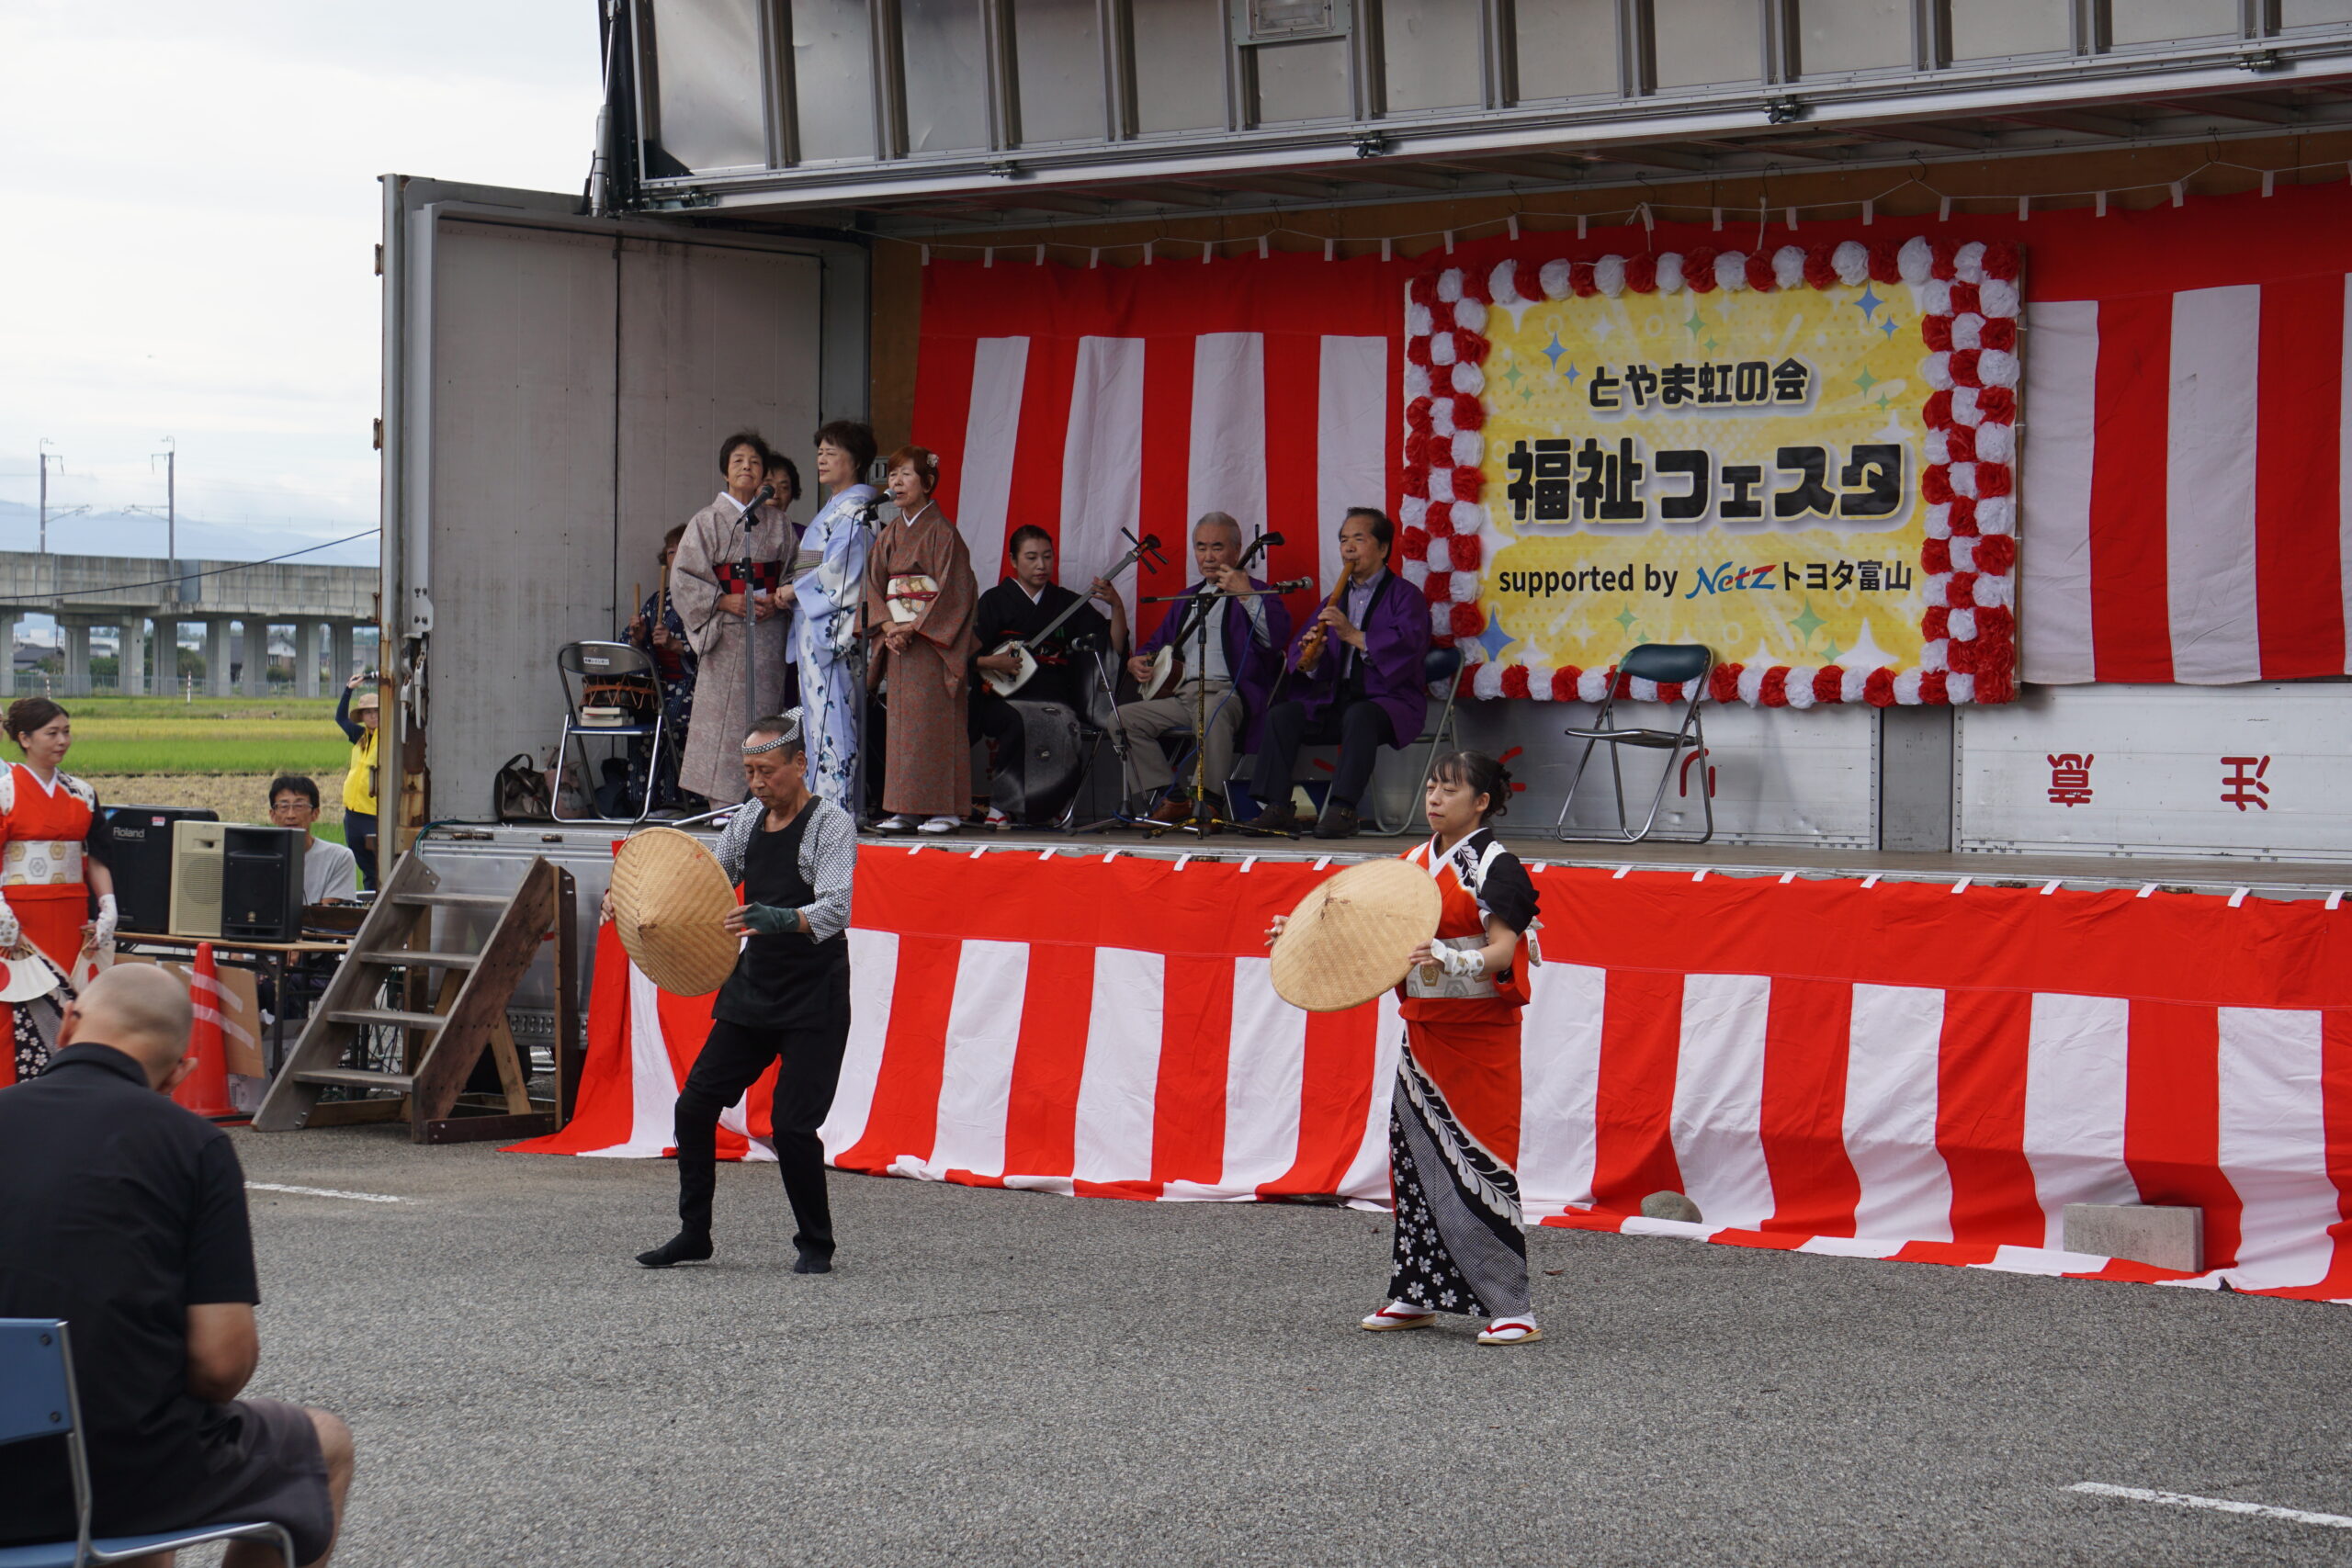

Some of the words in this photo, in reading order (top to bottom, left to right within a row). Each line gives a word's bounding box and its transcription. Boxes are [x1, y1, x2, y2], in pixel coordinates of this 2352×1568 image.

[1589, 358, 1808, 408] とやま虹の会
[1507, 438, 1903, 520] 福祉フェスタ
[1498, 564, 1634, 598] supported
[1645, 563, 1679, 598] by
[1783, 559, 1912, 592] トヨタ富山
[112, 826, 145, 838] Roland
